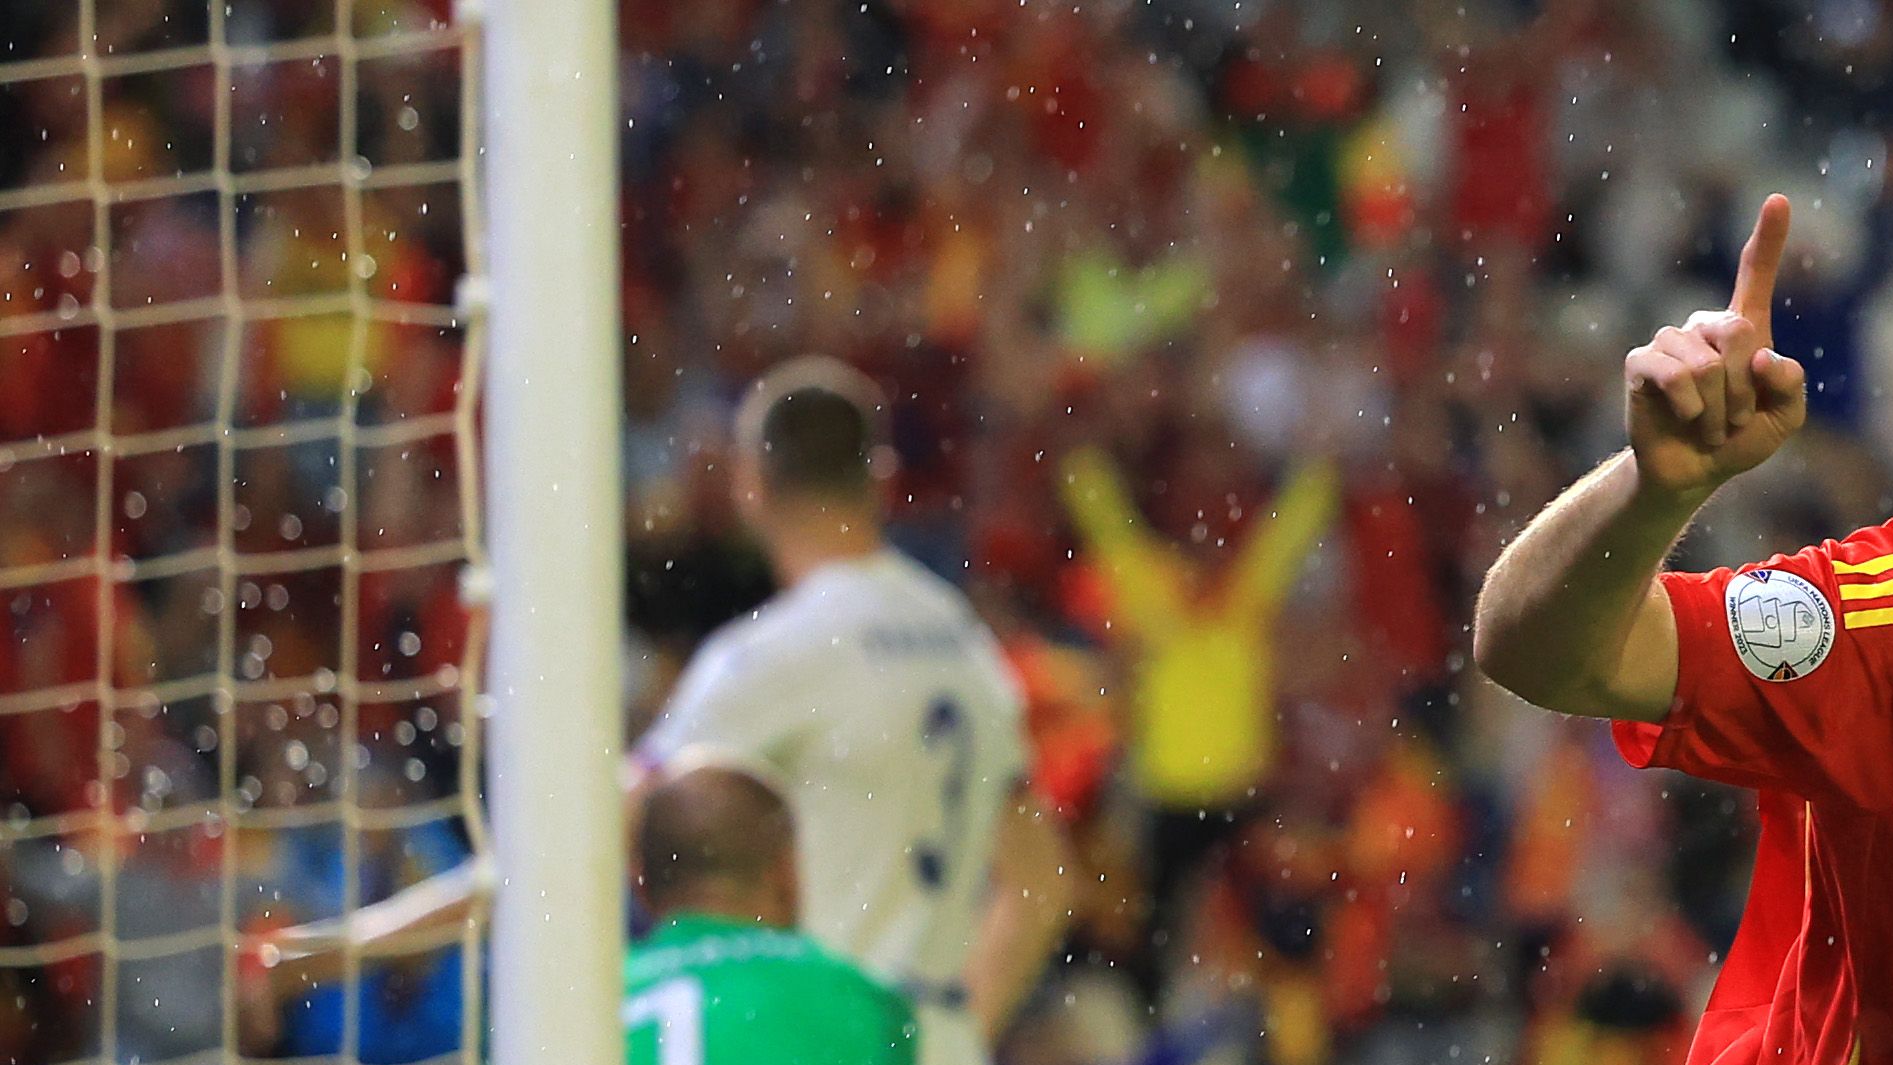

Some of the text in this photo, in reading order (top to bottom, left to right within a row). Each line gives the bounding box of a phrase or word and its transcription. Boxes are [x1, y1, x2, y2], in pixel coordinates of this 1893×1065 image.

[1729, 596, 1741, 631] WINNER
[1810, 590, 1831, 631] NATIONS
[1809, 632, 1831, 666] LEAGUE
